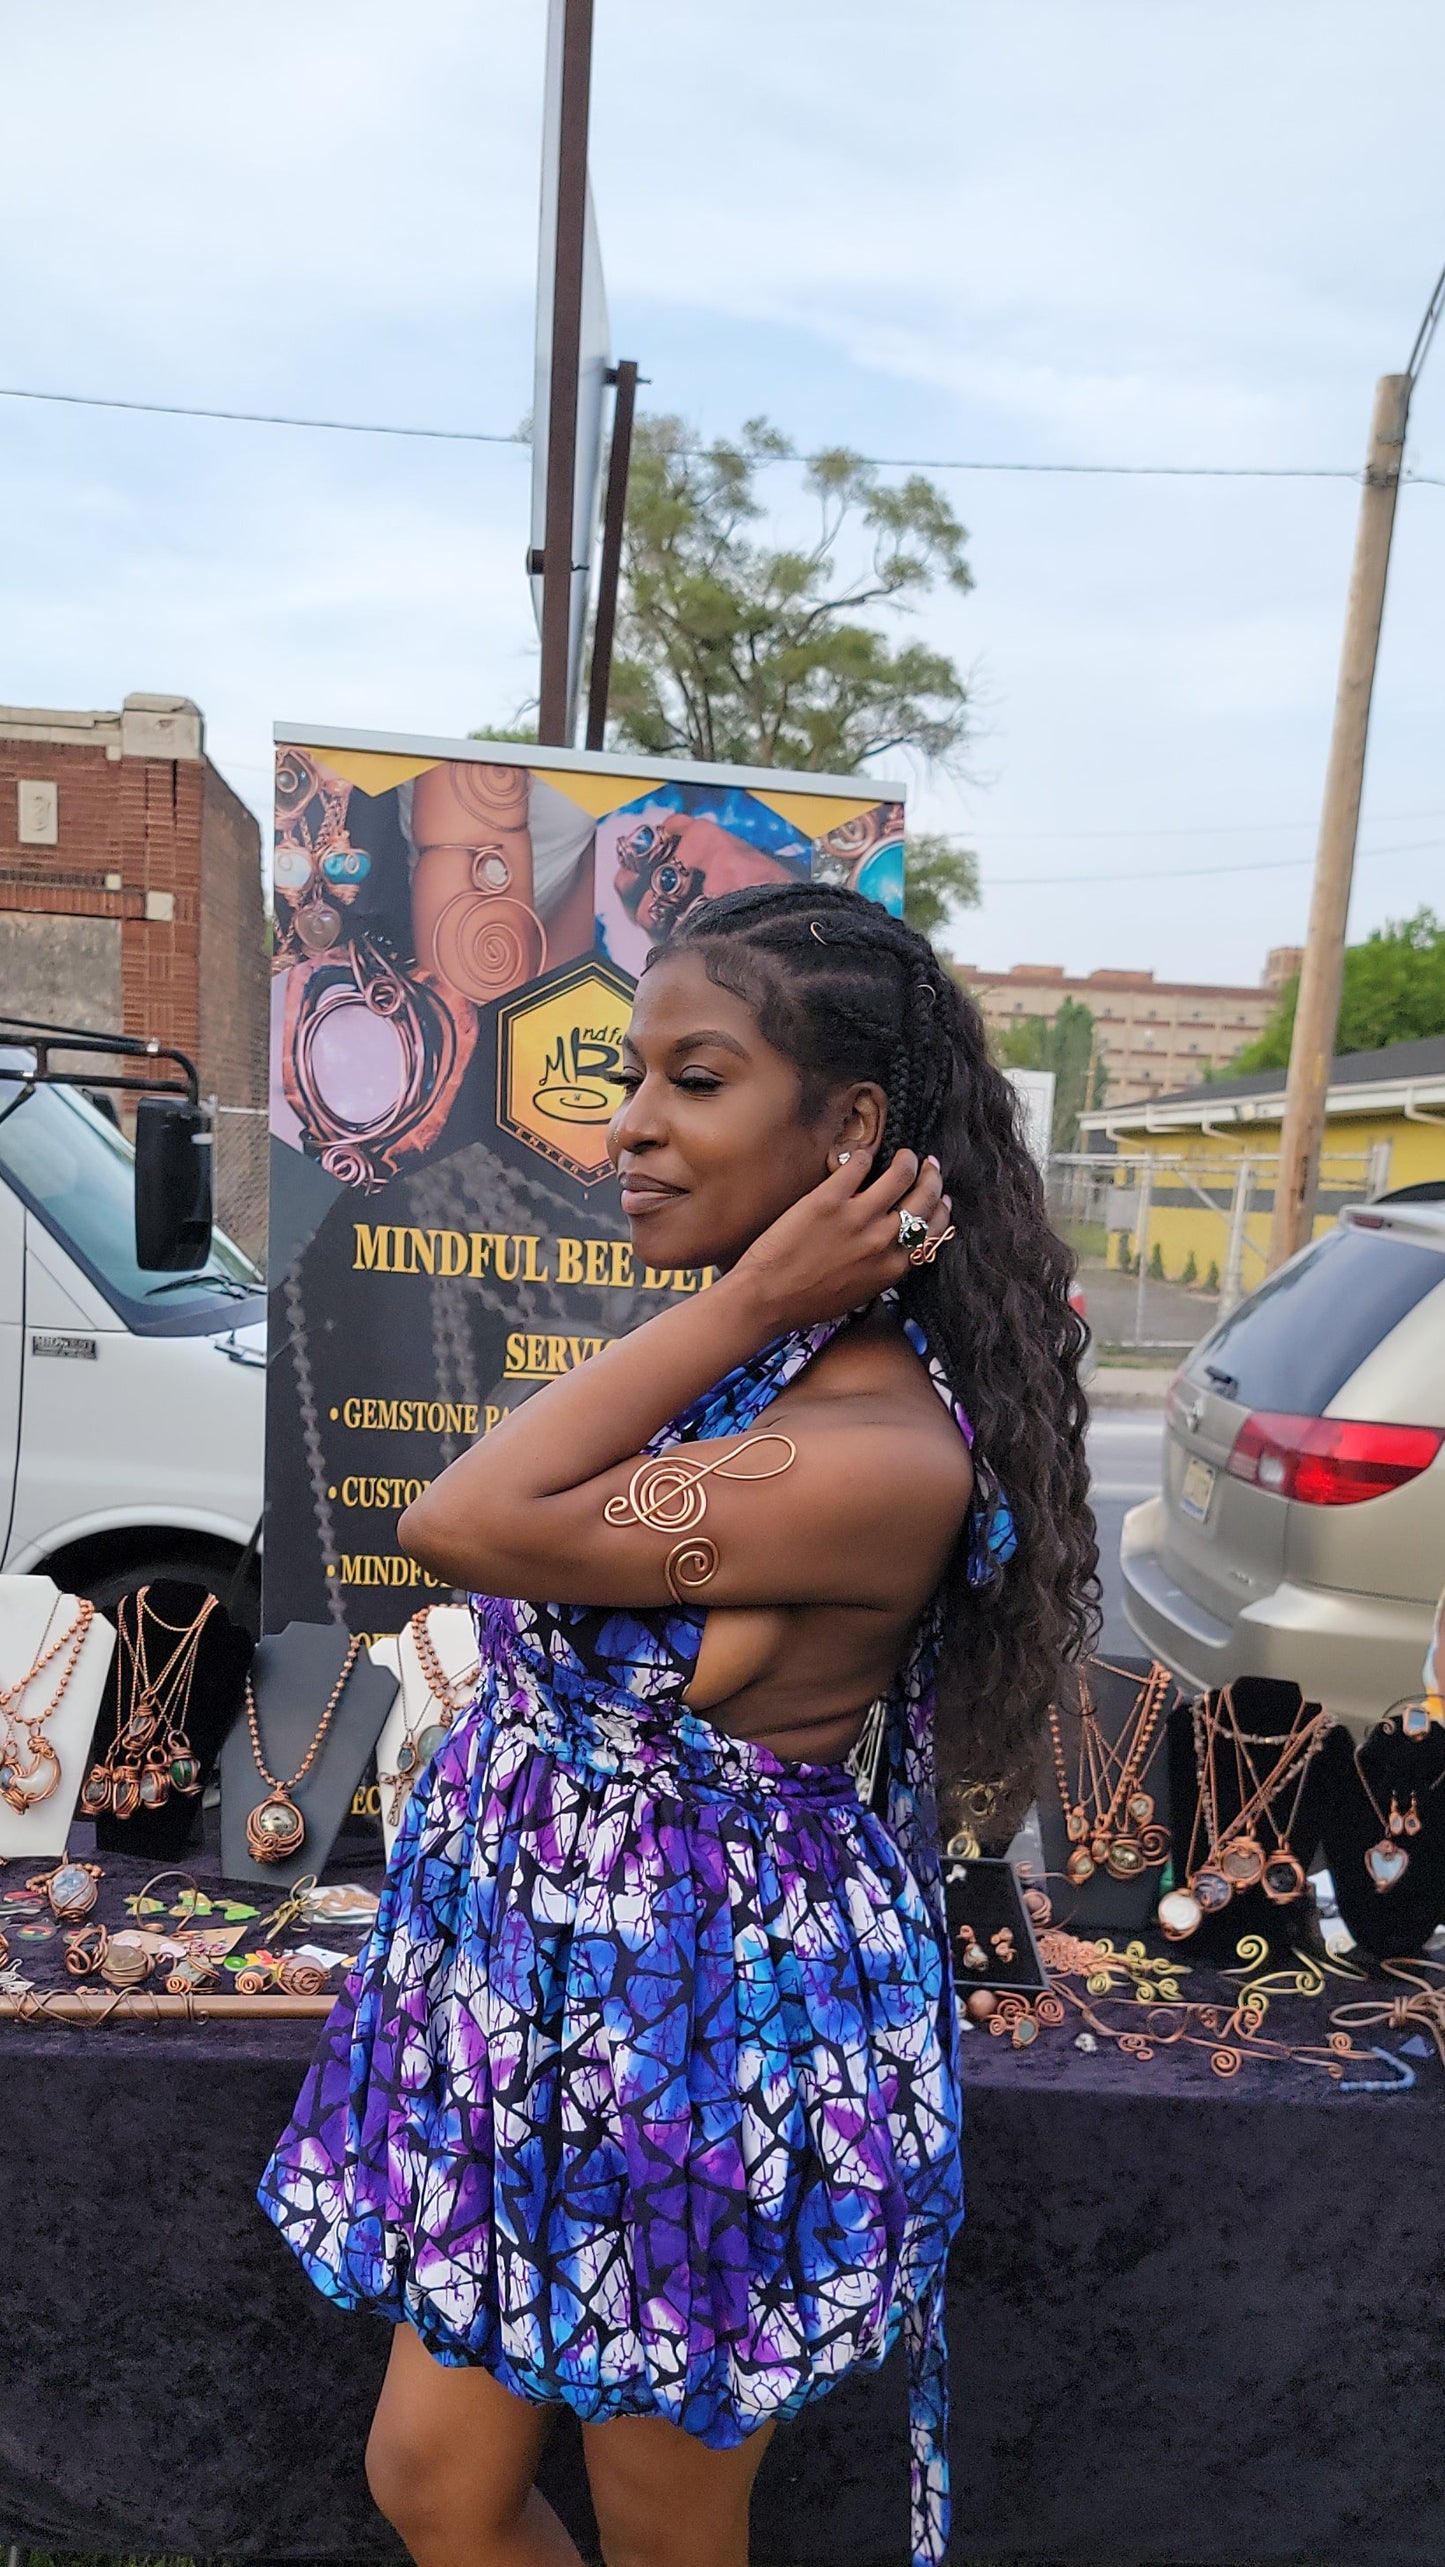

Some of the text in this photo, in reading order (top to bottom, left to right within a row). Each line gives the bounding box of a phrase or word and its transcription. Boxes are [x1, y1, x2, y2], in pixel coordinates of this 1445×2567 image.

[352, 1224, 548, 1283] MINDFUL
[556, 1238, 635, 1288] BEE
[343, 1398, 479, 1434] GEMSTONE
[341, 1476, 432, 1508] CUSTO
